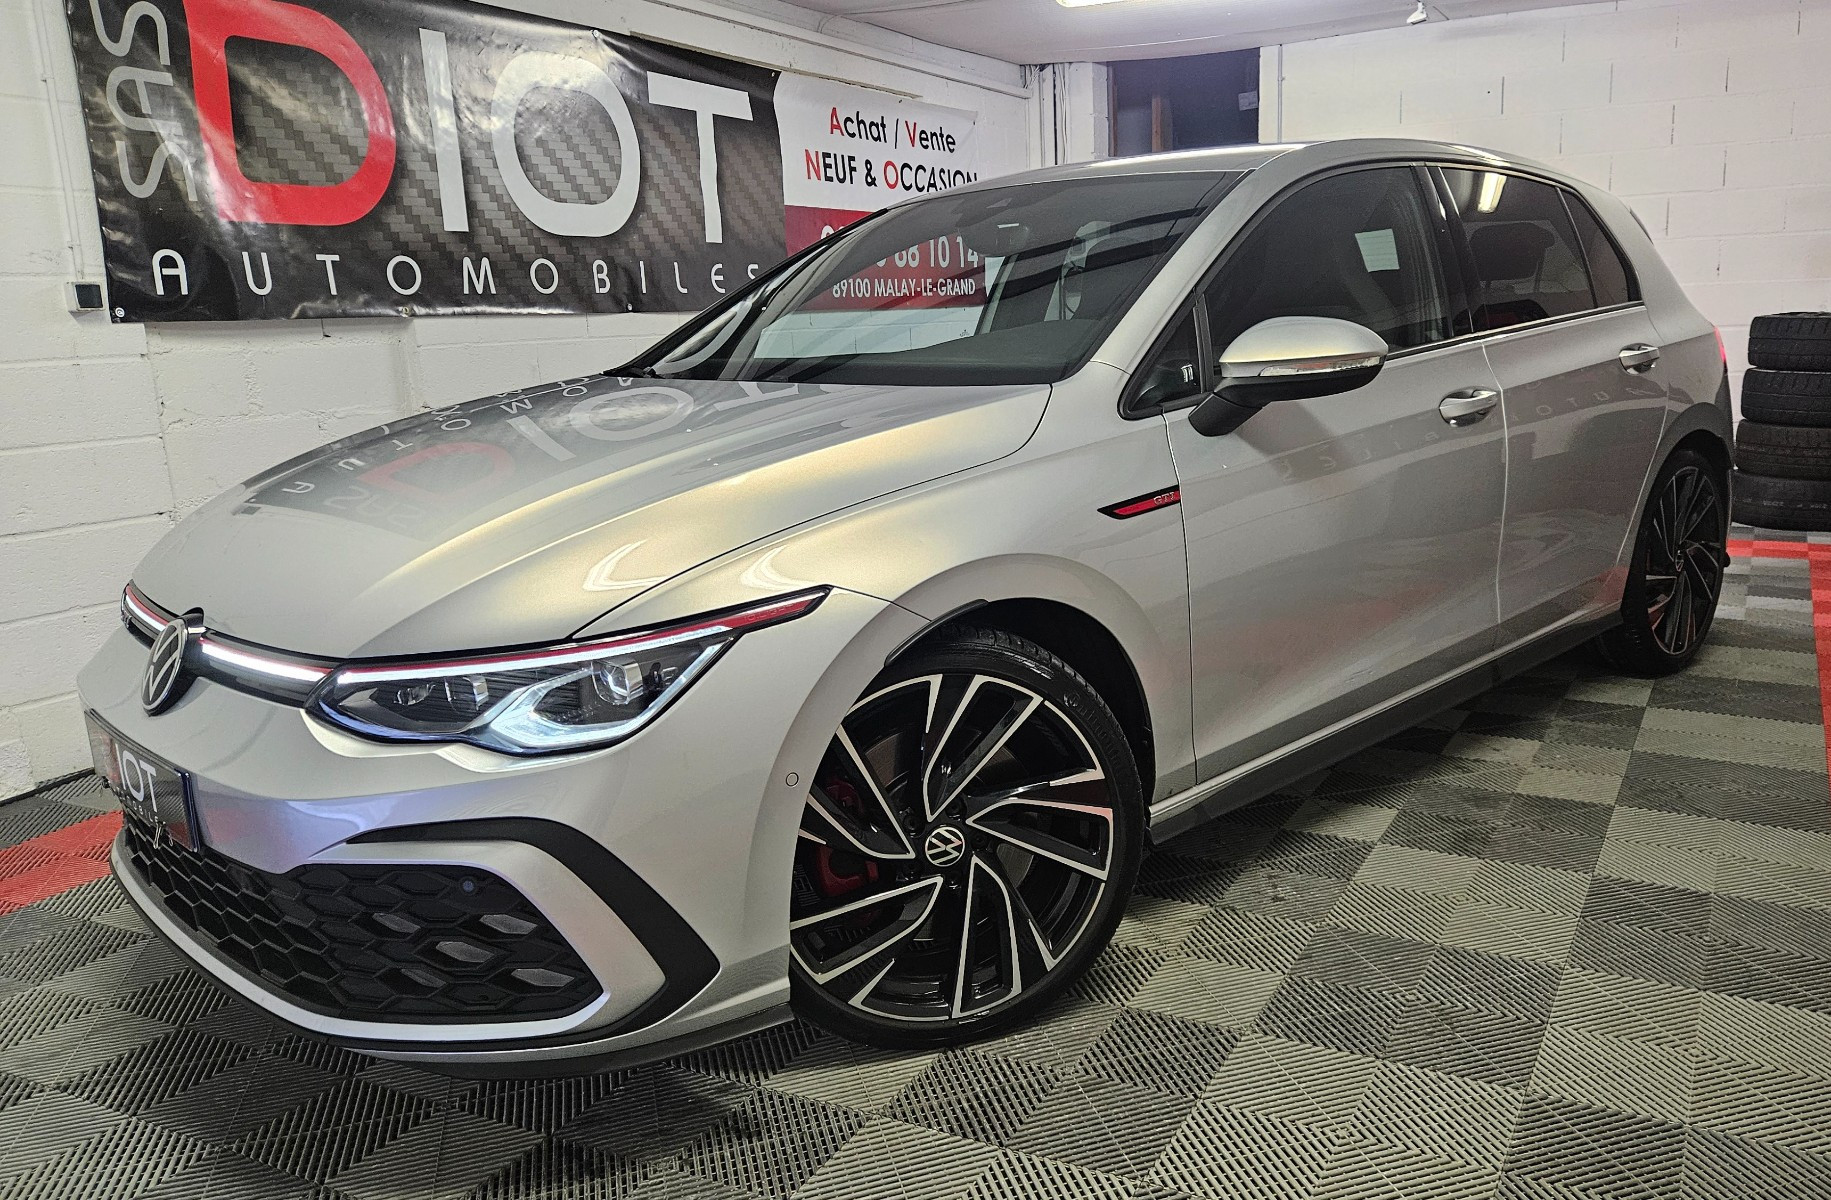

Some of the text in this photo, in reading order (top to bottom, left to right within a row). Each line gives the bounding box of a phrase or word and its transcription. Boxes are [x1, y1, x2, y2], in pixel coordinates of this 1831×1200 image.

[91, 0, 198, 202] SAS
[183, 0, 753, 243] DIOT
[830, 107, 956, 153] Achat / Vente
[805, 149, 857, 184] NEUF
[865, 159, 878, 187] &
[929, 236, 950, 268] 10
[832, 278, 976, 298] 89100 MALAY-LE-GRAND
[1153, 491, 1175, 505] GTI
